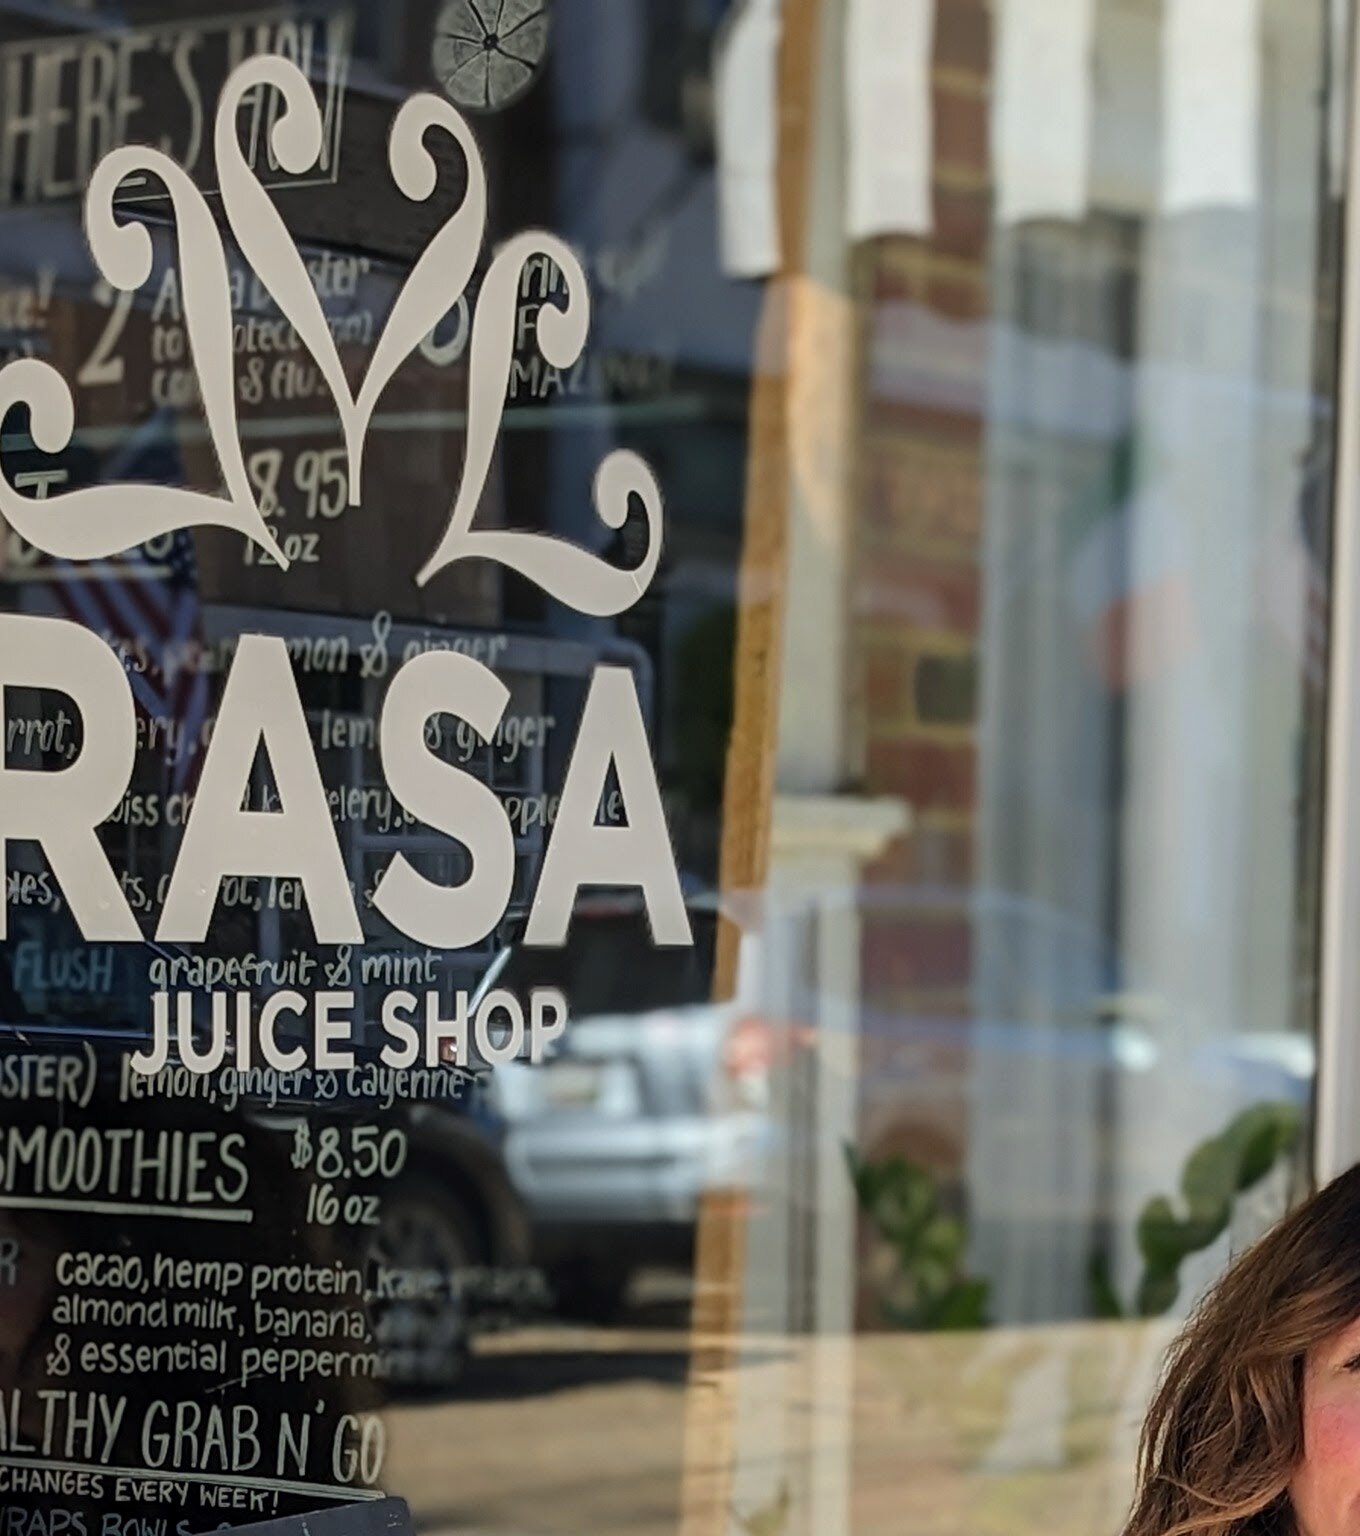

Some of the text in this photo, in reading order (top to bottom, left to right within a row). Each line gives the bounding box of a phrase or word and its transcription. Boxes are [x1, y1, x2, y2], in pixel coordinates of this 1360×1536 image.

[149, 949, 317, 993] grapefruit
[361, 949, 443, 987] mint
[130, 986, 568, 1075] JUICE SHOP
[291, 1123, 407, 1179] $8.50
[306, 1183, 381, 1225] 16 oz
[55, 1251, 149, 1295] cacao,
[153, 1253, 243, 1297] hemp
[250, 1260, 374, 1303] protein,
[52, 1294, 373, 1345] almond milk, banana,
[80, 1339, 228, 1376] essential
[141, 1400, 261, 1473] GRAB
[332, 1415, 387, 1485] GO
[115, 1477, 190, 1506] EVERY
[199, 1484, 281, 1515] WEEK!
